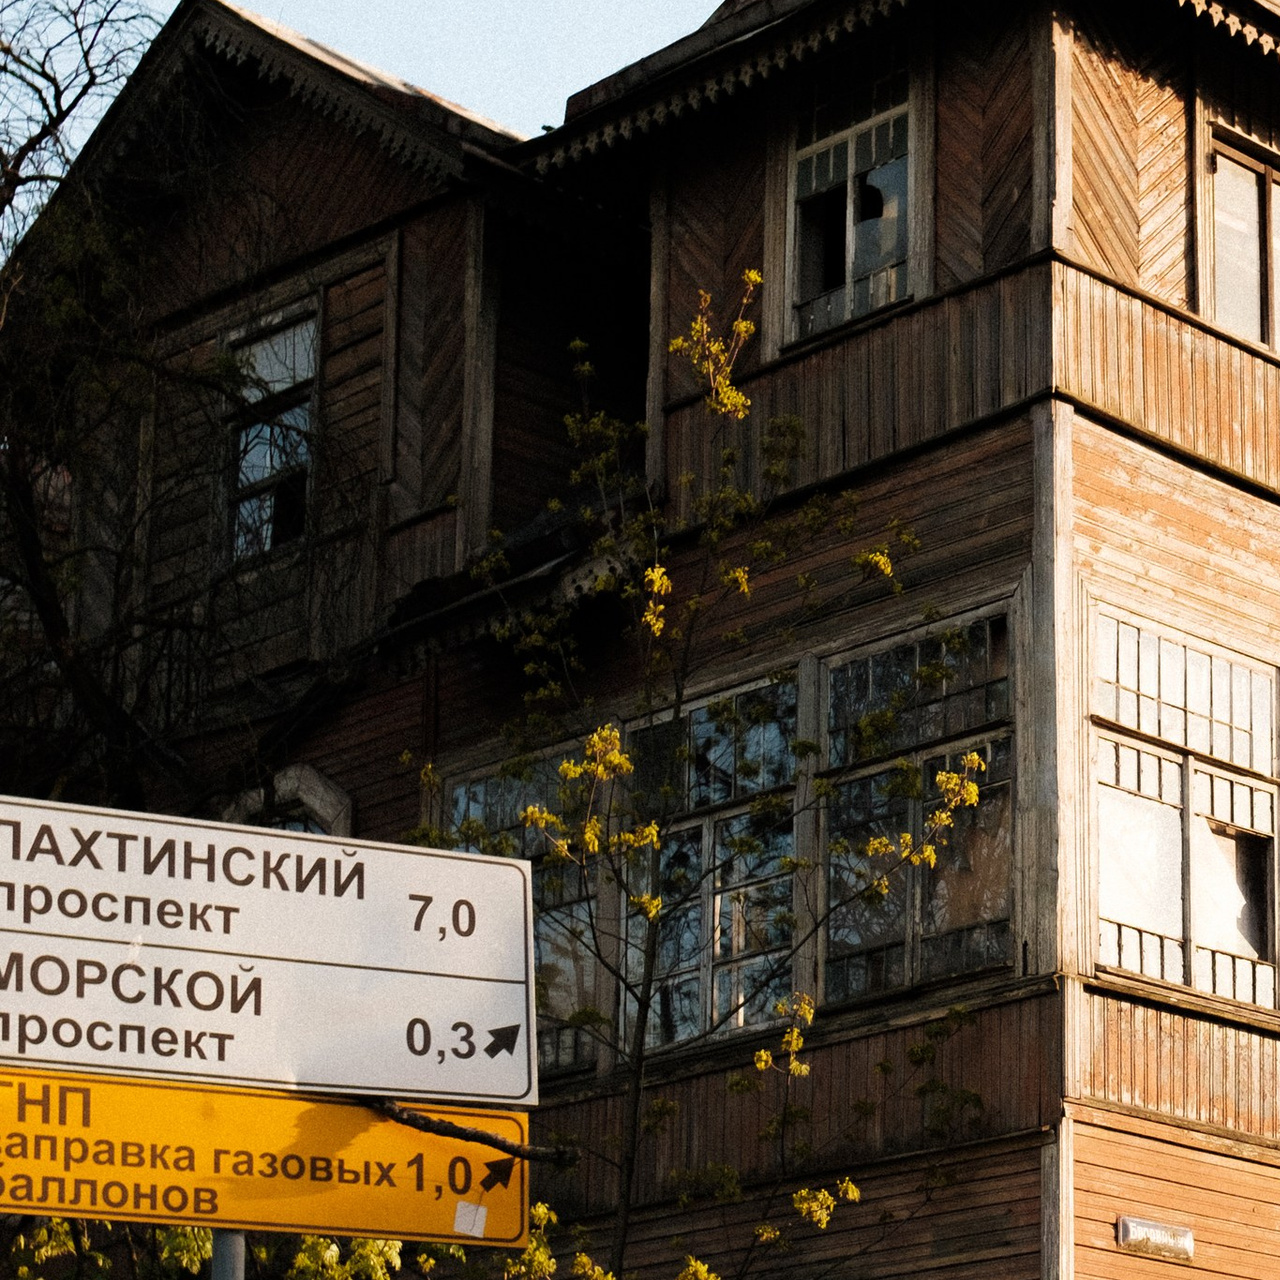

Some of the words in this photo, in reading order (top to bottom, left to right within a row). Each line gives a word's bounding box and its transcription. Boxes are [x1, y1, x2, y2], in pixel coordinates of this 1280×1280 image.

[0, 881, 240, 934] проспект
[408, 893, 476, 941] 7,0
[406, 1017, 476, 1064] 0,3
[0, 1130, 196, 1172] аправка
[213, 1148, 397, 1187] газовых
[406, 1152, 472, 1201] 1,0
[0, 1173, 219, 1214] аллонов
